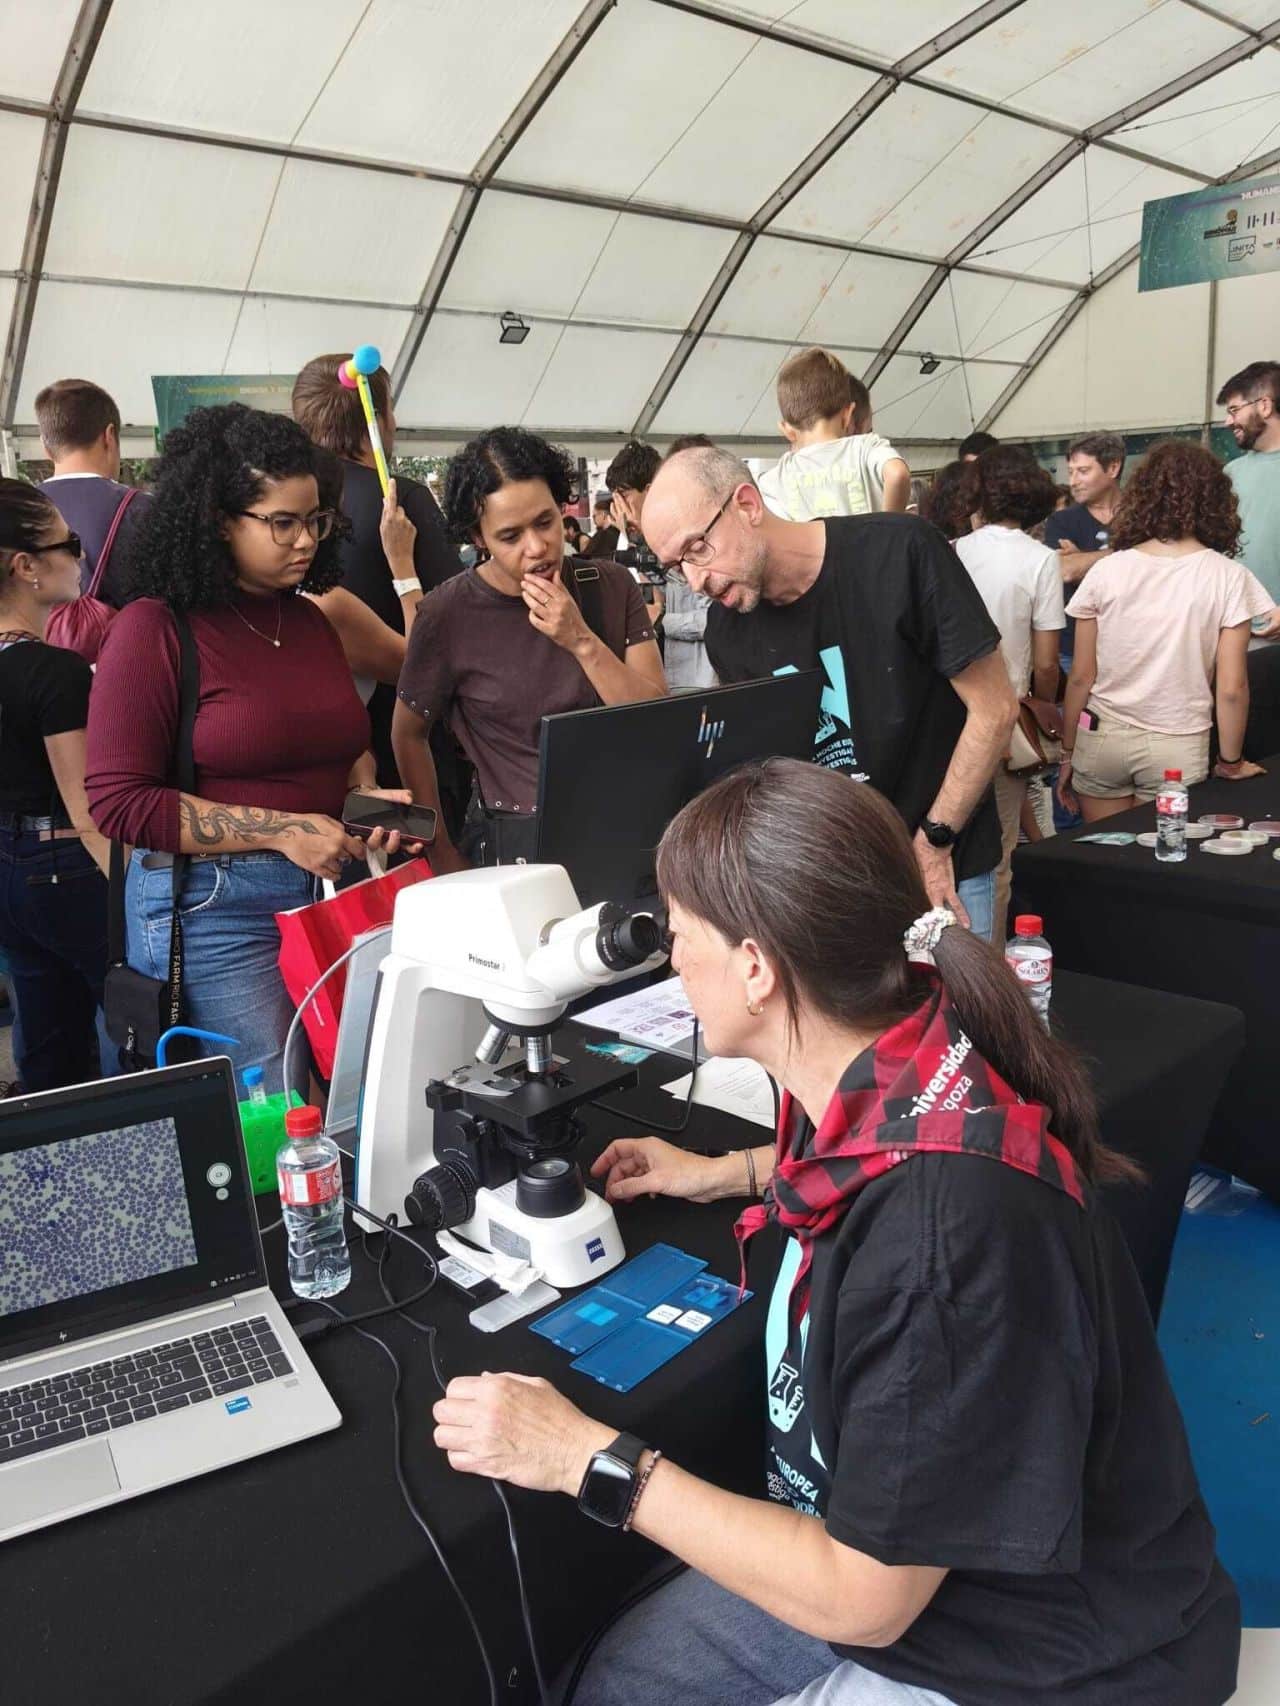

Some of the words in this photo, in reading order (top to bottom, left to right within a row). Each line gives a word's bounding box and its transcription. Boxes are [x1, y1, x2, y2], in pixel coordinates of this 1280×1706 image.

[468, 952, 500, 970] Primostar
[900, 1029, 974, 1118] niversidad
[938, 1075, 974, 1111] goza
